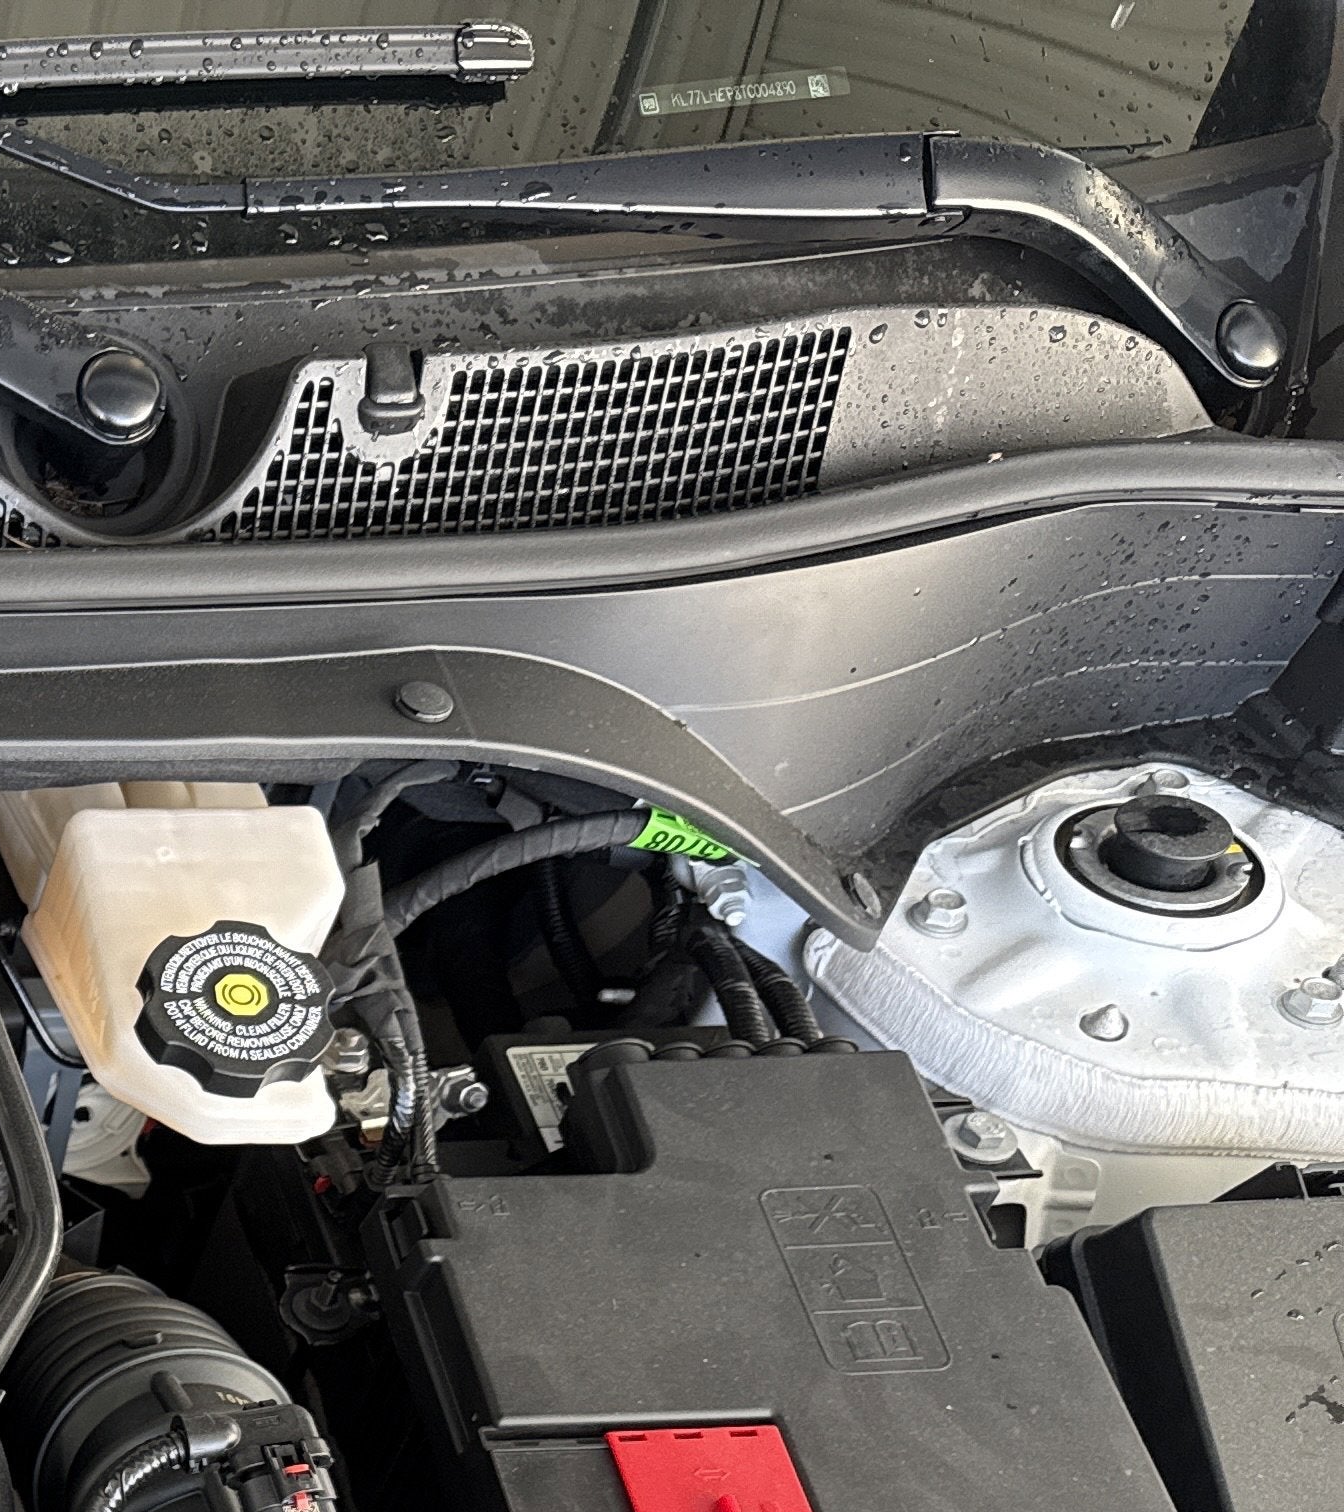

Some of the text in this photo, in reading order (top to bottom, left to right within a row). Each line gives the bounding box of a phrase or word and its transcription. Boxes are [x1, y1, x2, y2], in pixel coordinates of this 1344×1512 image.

[218, 931, 232, 943] LE
[261, 951, 277, 965] DE
[177, 999, 197, 1019] CAP
[188, 1015, 227, 1044] BEFORE
[286, 1004, 308, 1027] ONLY
[234, 1020, 271, 1037] CLEAN
[265, 1002, 292, 1029] FILLER
[177, 1022, 209, 1048] FLUID
[205, 1040, 239, 1058] FROM
[240, 1049, 249, 1060] A
[249, 1040, 291, 1063] SEALED
